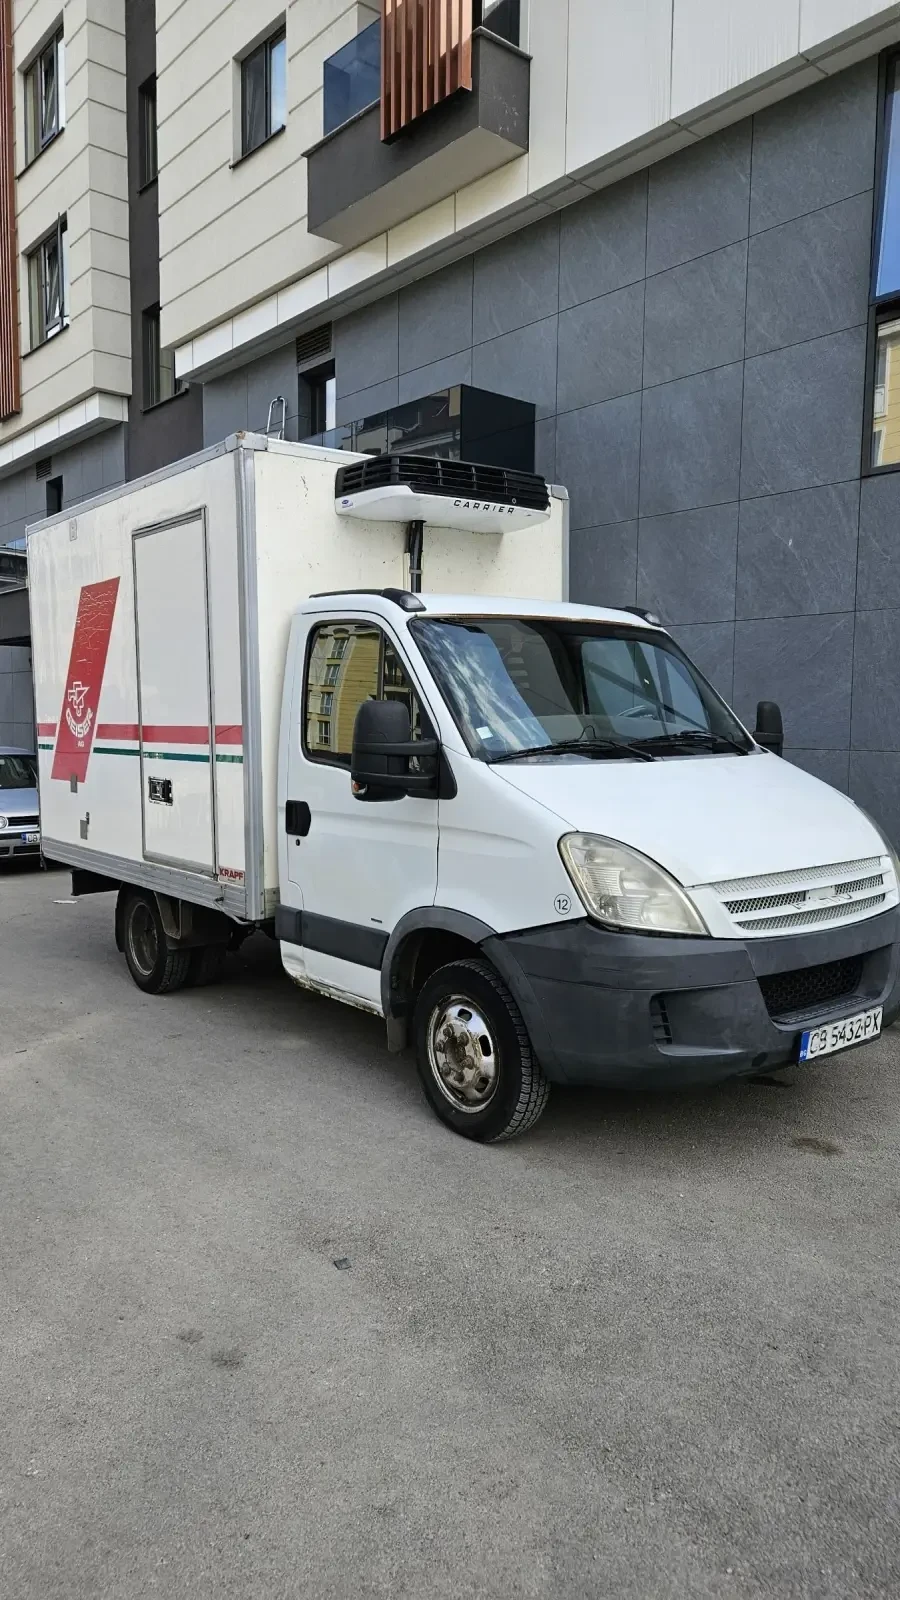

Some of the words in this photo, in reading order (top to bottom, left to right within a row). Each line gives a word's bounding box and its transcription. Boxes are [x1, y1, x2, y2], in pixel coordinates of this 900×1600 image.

[453, 499, 515, 514] CARRIER
[28, 834, 38, 843] CB
[219, 867, 244, 881] KRAPF
[556, 898, 569, 911] 12
[810, 1029, 828, 1054] CB
[831, 1019, 862, 1048] 5432
[863, 1010, 882, 1036] PX
